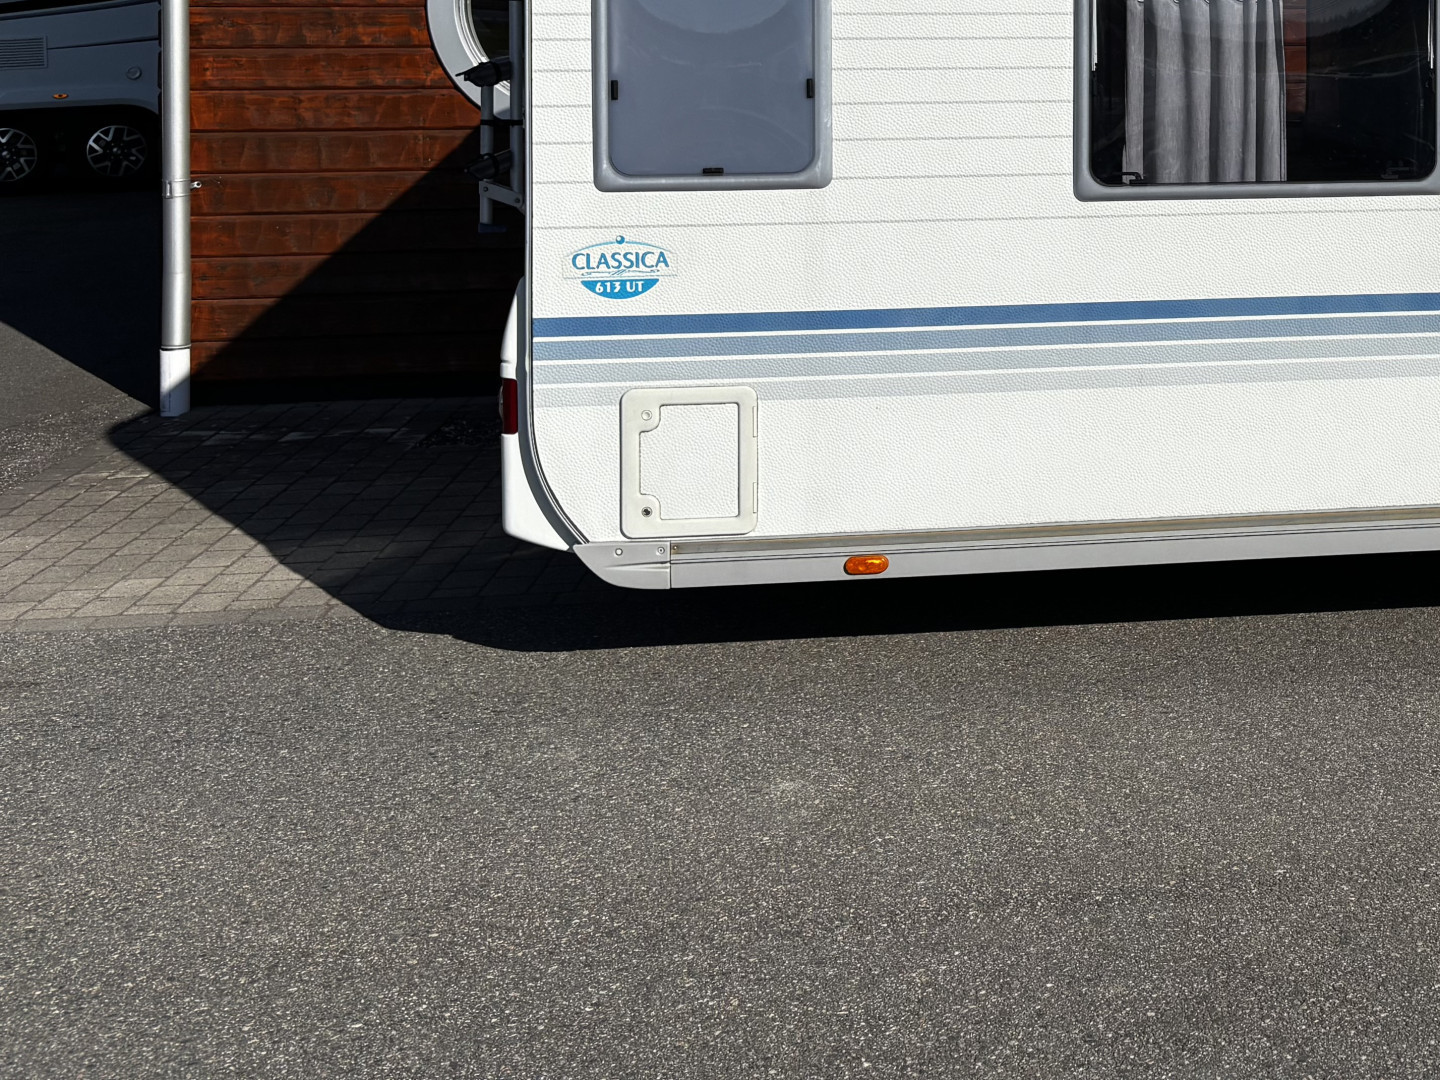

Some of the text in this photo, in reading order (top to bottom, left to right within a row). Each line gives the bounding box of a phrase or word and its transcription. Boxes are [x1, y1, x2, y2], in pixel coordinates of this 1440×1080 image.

[571, 250, 670, 270] CLASSICA
[595, 281, 645, 293] 613 UT
